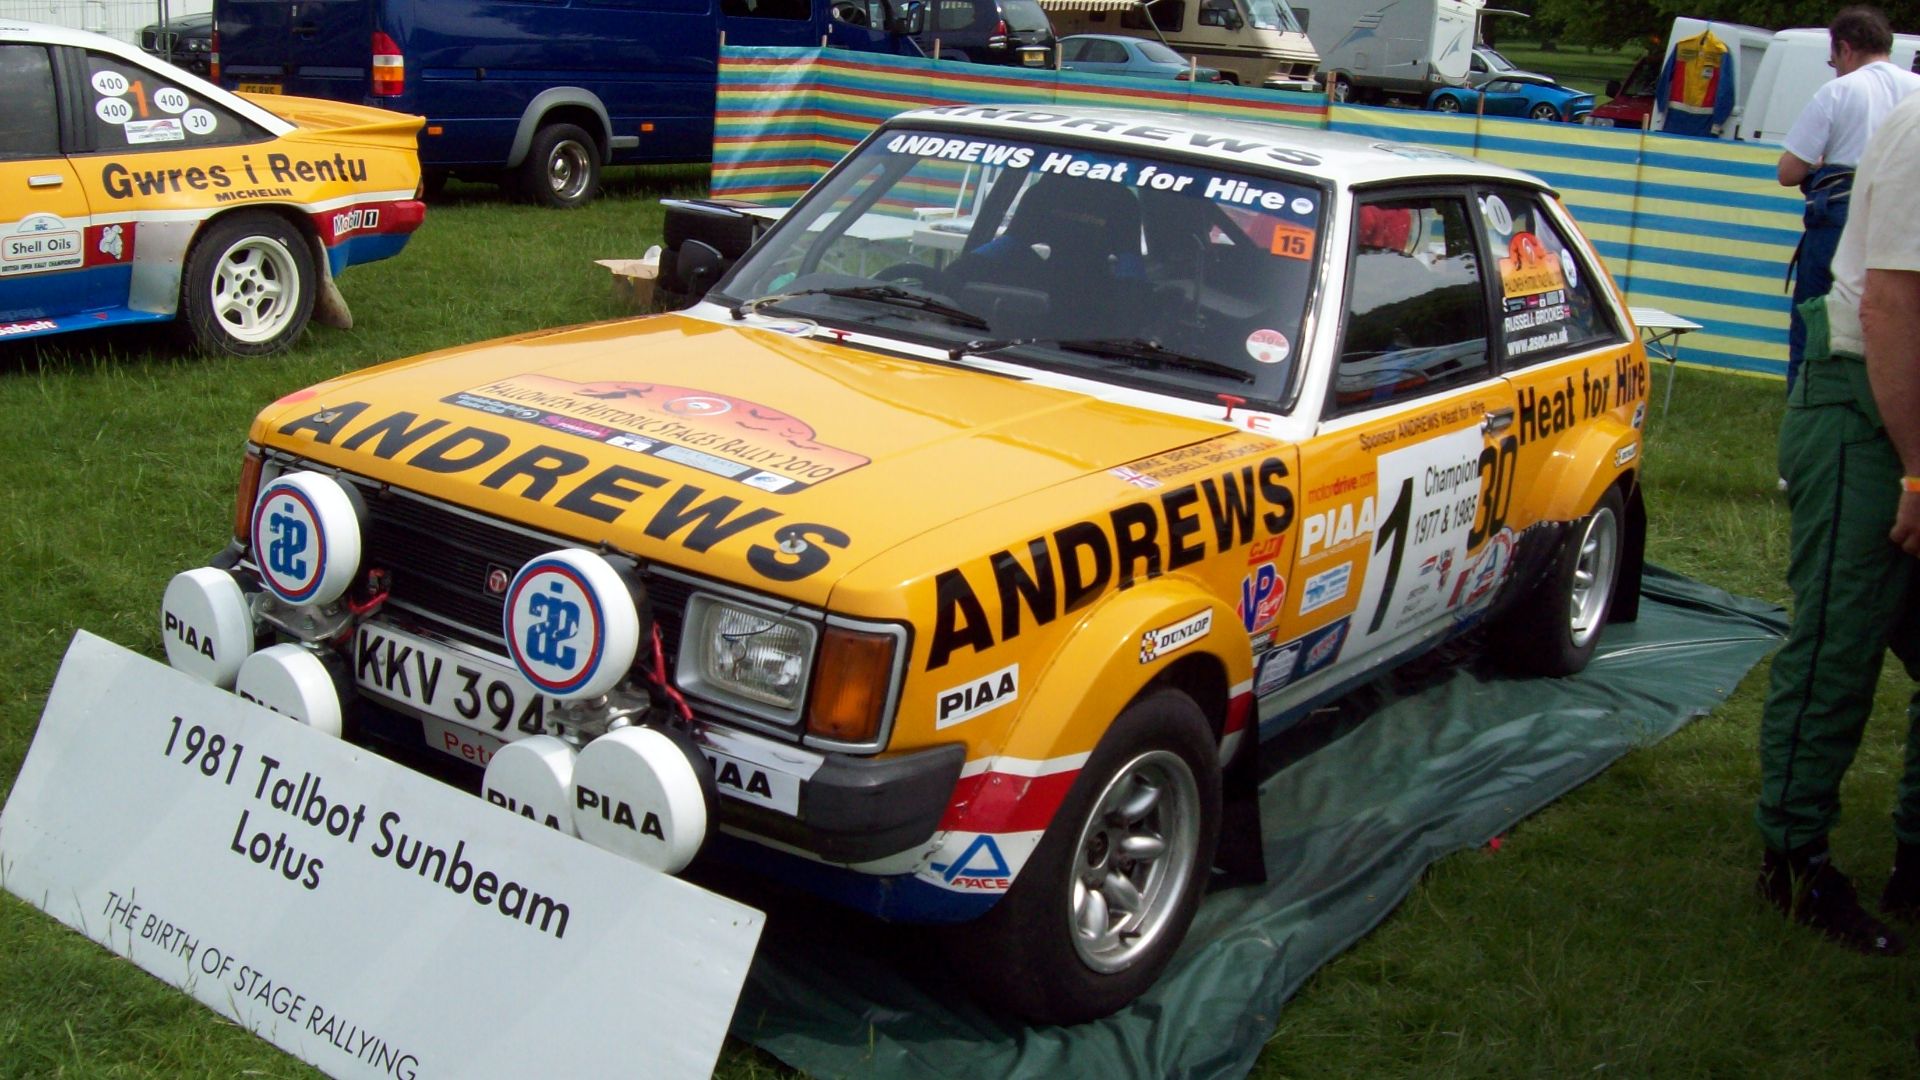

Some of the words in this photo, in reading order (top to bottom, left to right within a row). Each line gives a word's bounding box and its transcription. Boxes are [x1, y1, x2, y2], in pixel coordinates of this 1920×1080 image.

[100, 78, 123, 90] 400
[128, 80, 149, 118] 1
[160, 94, 184, 107] 400
[103, 104, 127, 117] 400
[192, 115, 207, 128] 30
[911, 104, 1325, 167] ANDREWS
[101, 162, 233, 200] Gwres
[241, 154, 260, 185] i
[267, 152, 368, 183] Rentu
[215, 187, 293, 202] MICHELIN
[886, 134, 1035, 169] ANDREWS
[1040, 152, 1128, 184] Heat
[1135, 165, 1194, 192] for
[1204, 177, 1286, 210] Hire
[12, 241, 42, 255] Shell
[47, 239, 72, 251] Oils
[334, 210, 362, 236] Mobil
[1280, 235, 1307, 255] 15
[1504, 310, 1536, 333] RUSSELL
[1535, 304, 1565, 327] BROOKES
[1517, 386, 1575, 446] Heat
[1583, 367, 1610, 420] for
[1615, 354, 1646, 408] Hire
[484, 381, 575, 411] HALLOWEEN
[573, 402, 662, 431] HISTORIC
[650, 421, 718, 450] STAGES
[713, 438, 785, 468] RALLY
[769, 456, 835, 479] 2010
[1358, 428, 1396, 455] Sponsor
[1398, 412, 1441, 439] ANDREWS
[1441, 408, 1458, 426] Heat
[1458, 406, 1470, 422] for
[1471, 401, 1486, 417] Hire
[240, 401, 852, 583] ANDREWS
[1308, 471, 1376, 504] motordrive.com
[1424, 455, 1479, 498] Champion
[1466, 434, 1518, 551] 30
[1301, 496, 1376, 558] PIAA
[1414, 508, 1441, 546] 1977
[1440, 504, 1450, 534] &
[1453, 494, 1478, 530] 1985
[925, 456, 1297, 673] ANDREWS
[1366, 476, 1414, 636] 1
[1243, 563, 1276, 634] VP
[165, 610, 216, 662] PIAA
[1160, 617, 1209, 649] DUNLOP
[357, 629, 442, 706] KKV
[453, 665, 566, 735] 394
[939, 672, 1016, 721] PIAA
[163, 715, 246, 785] 1981
[252, 757, 368, 844] Talbot
[371, 811, 572, 940] Sunbeam
[576, 783, 666, 841] PIAA
[230, 810, 325, 892] Lotus
[103, 891, 142, 931] THE
[140, 913, 199, 961] BIRTH
[201, 947, 235, 980] OF
[233, 965, 307, 1023] STAGE
[305, 1004, 419, 1080] RALLYING
